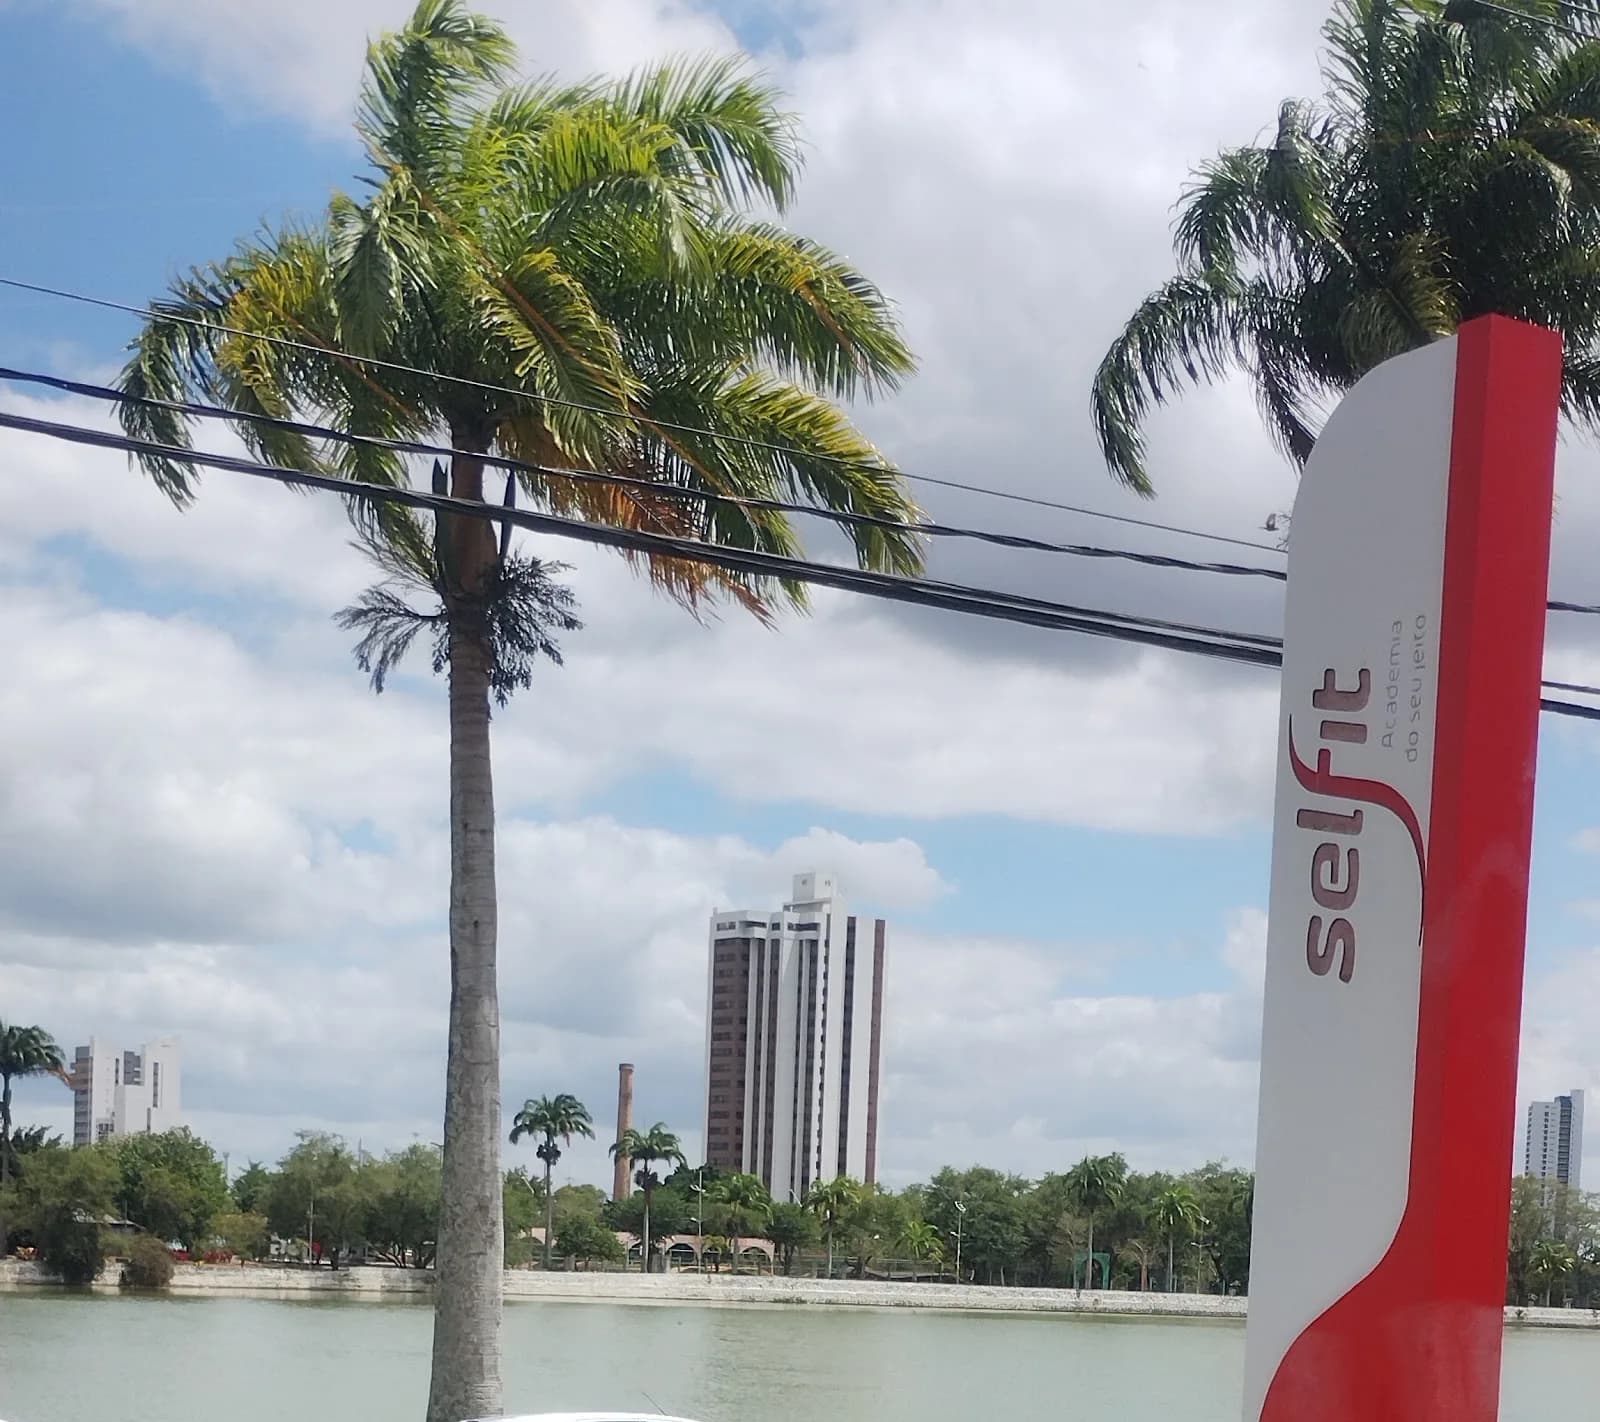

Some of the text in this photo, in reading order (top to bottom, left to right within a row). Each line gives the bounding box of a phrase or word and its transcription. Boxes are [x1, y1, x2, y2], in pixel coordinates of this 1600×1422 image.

[1381, 620, 1403, 748] Academia
[1406, 614, 1427, 763] do seu jeito
[1289, 667, 1427, 984] selfit
